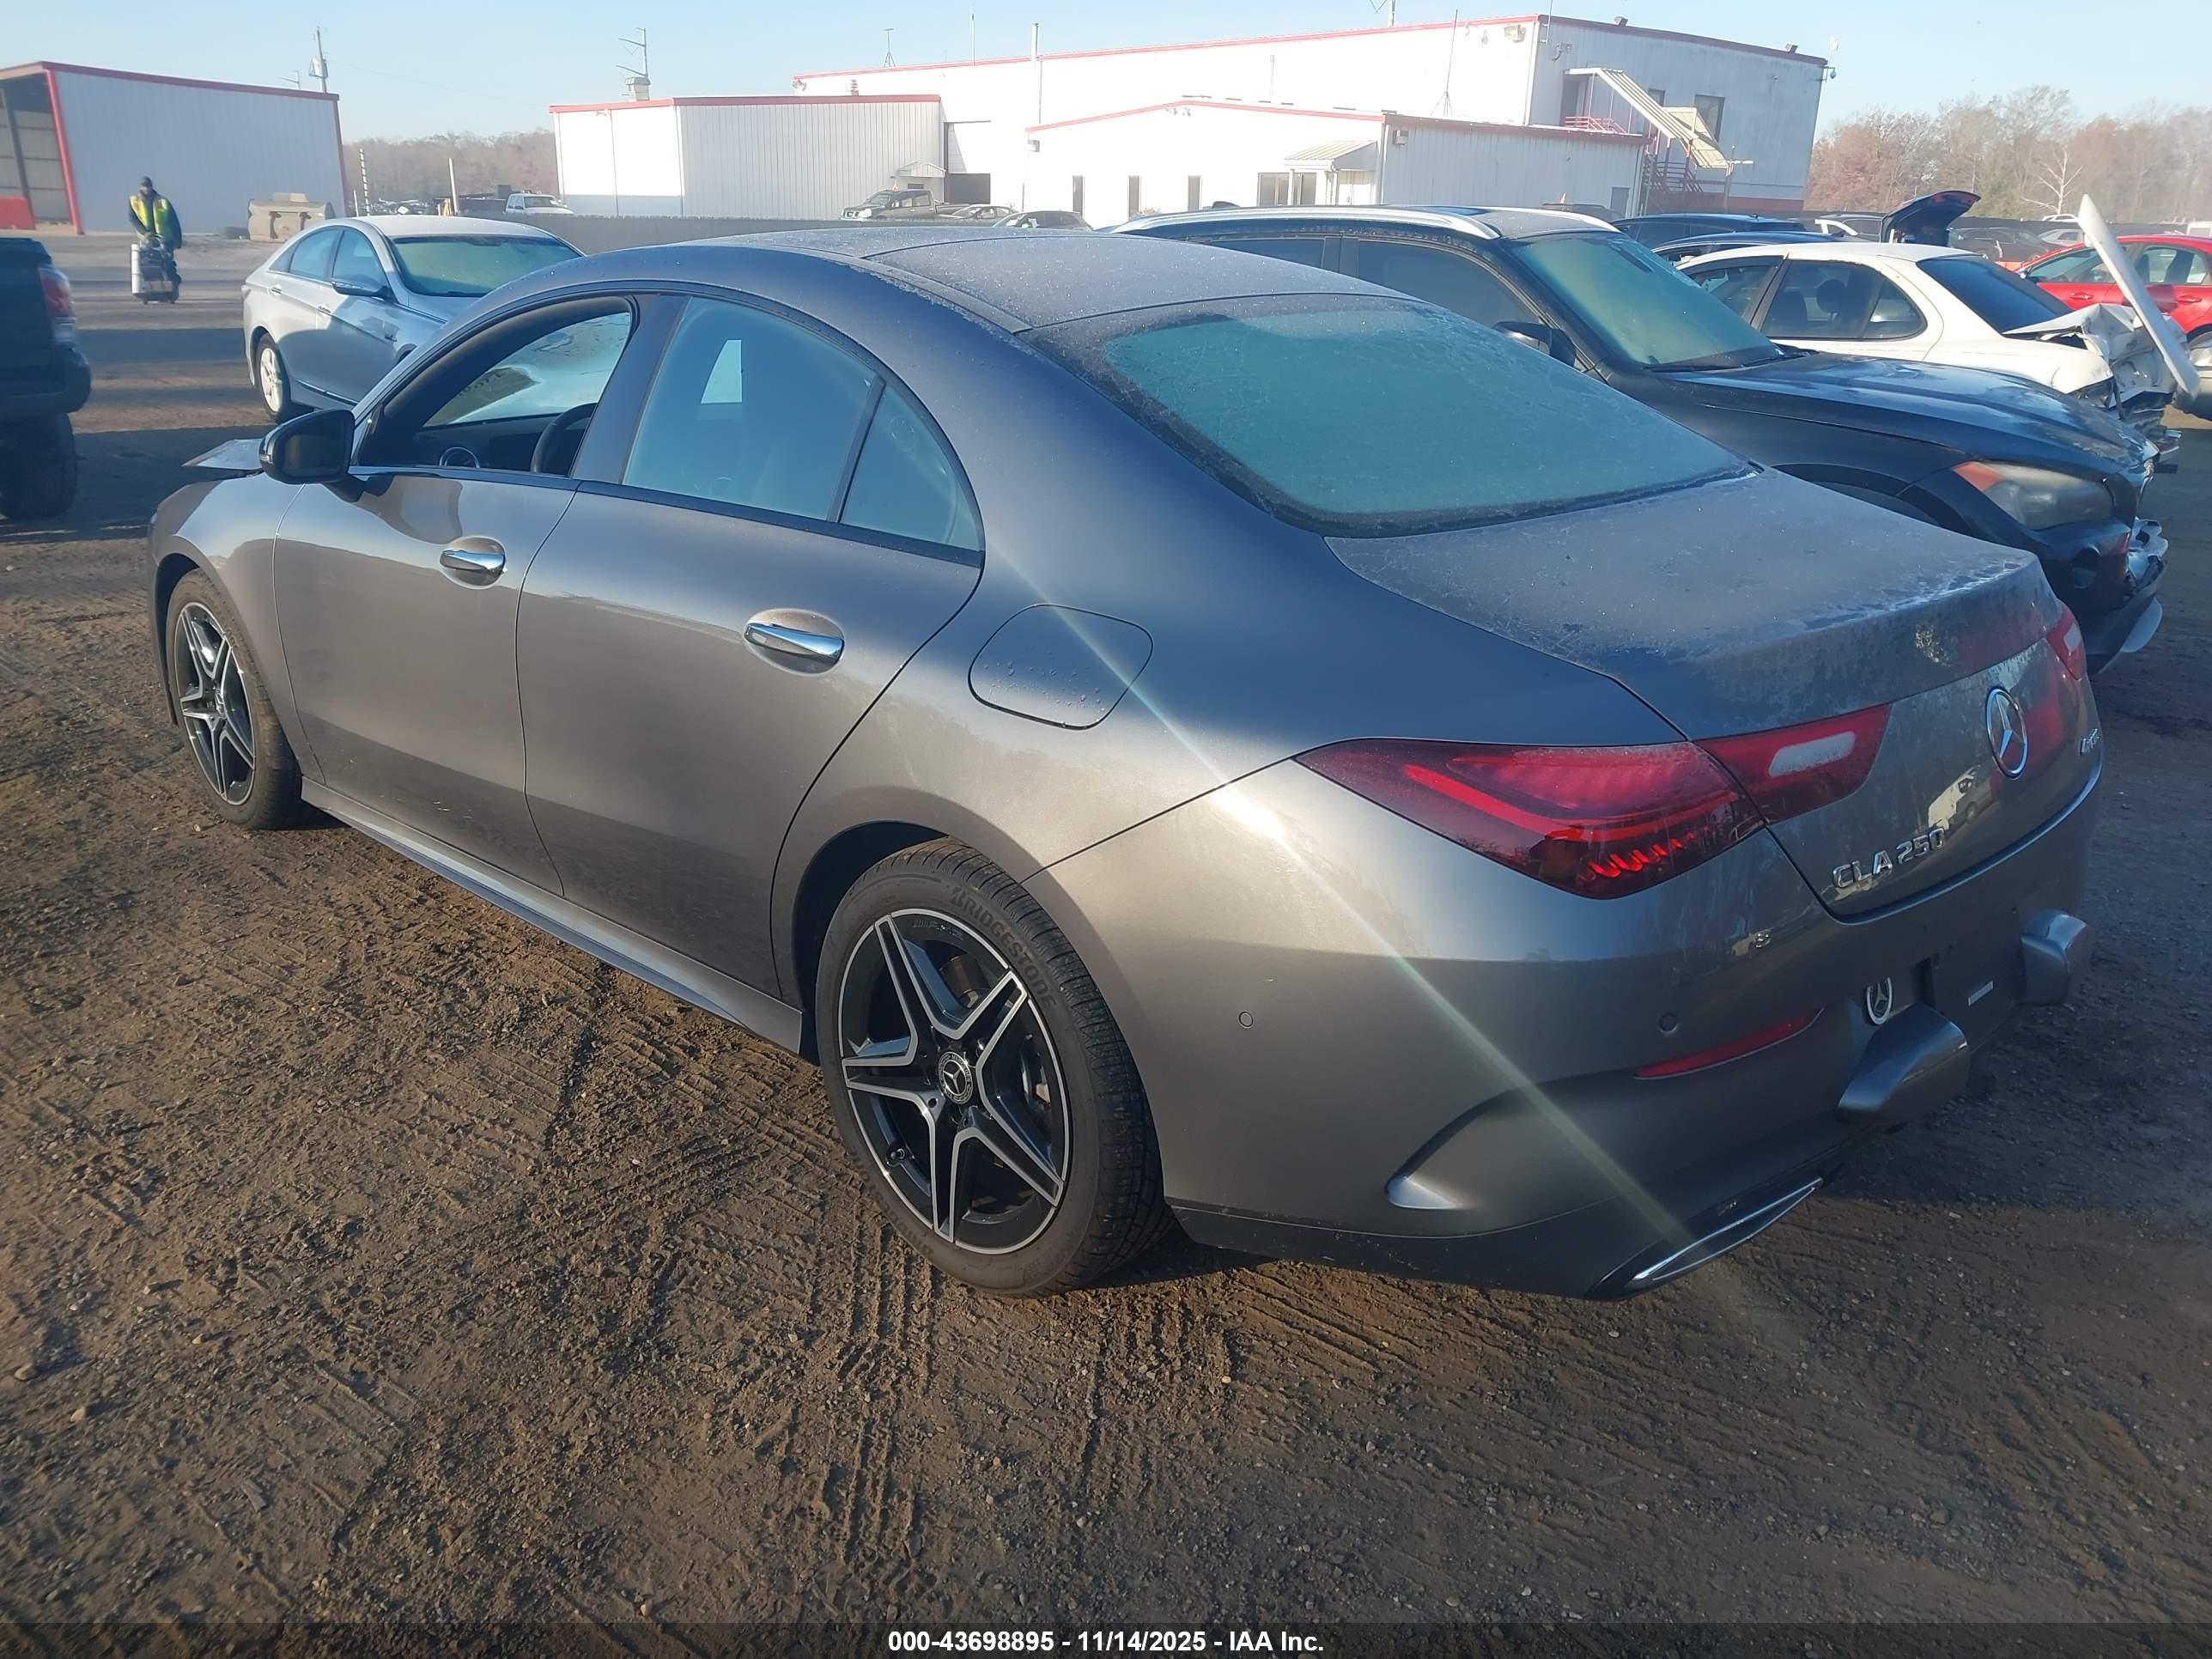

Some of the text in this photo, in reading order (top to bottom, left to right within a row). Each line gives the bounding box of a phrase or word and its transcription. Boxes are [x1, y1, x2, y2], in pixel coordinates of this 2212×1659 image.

[1832, 827, 1947, 889] CLA 250
[949, 886, 1058, 1008] BRIDGESTONE
